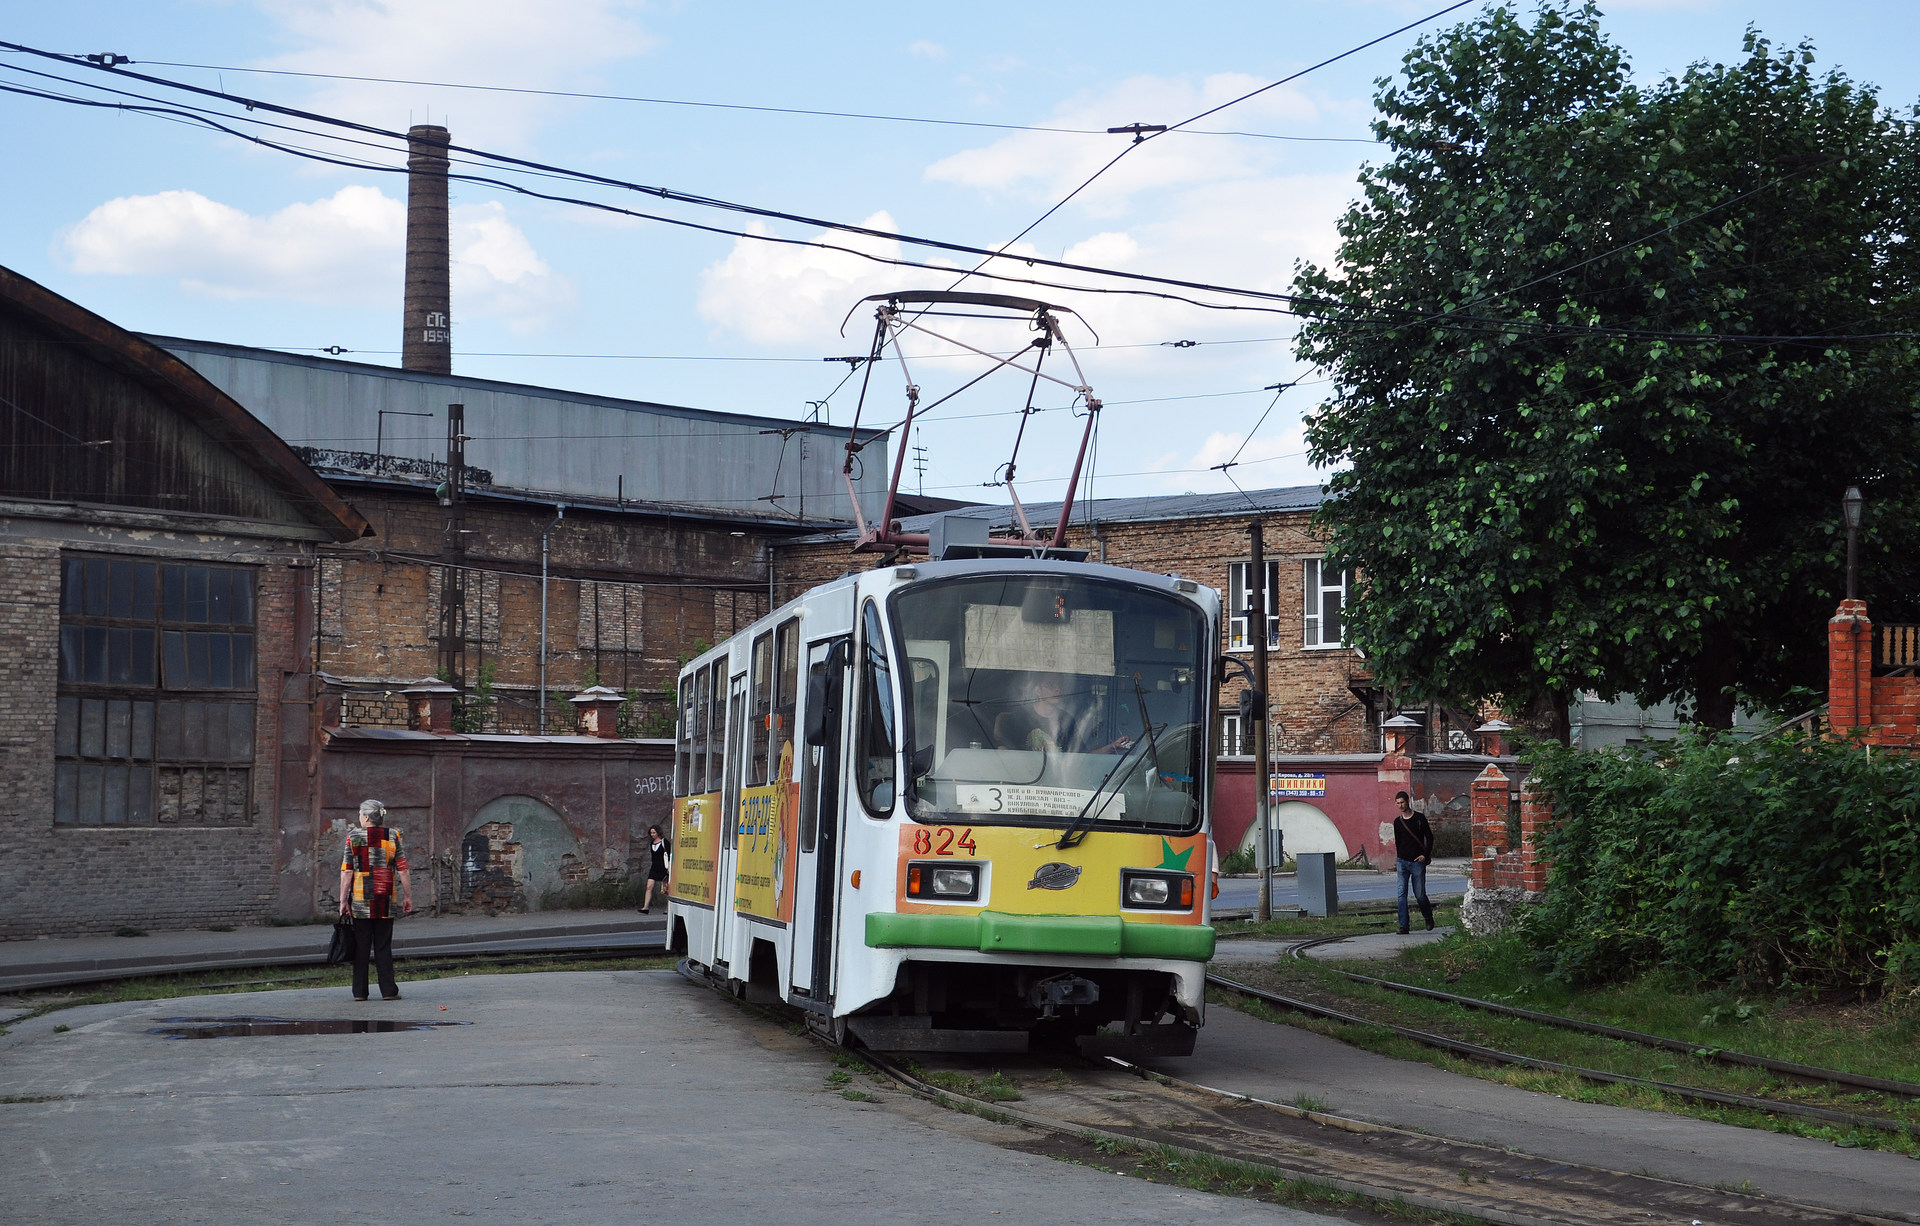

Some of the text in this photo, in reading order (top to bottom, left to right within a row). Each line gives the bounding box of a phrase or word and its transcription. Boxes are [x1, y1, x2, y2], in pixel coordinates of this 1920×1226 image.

[424, 330, 449, 342] 1954
[1271, 780, 1324, 788] ДШИПНИКИ
[988, 788, 1003, 812] 3
[913, 827, 977, 856] 824
